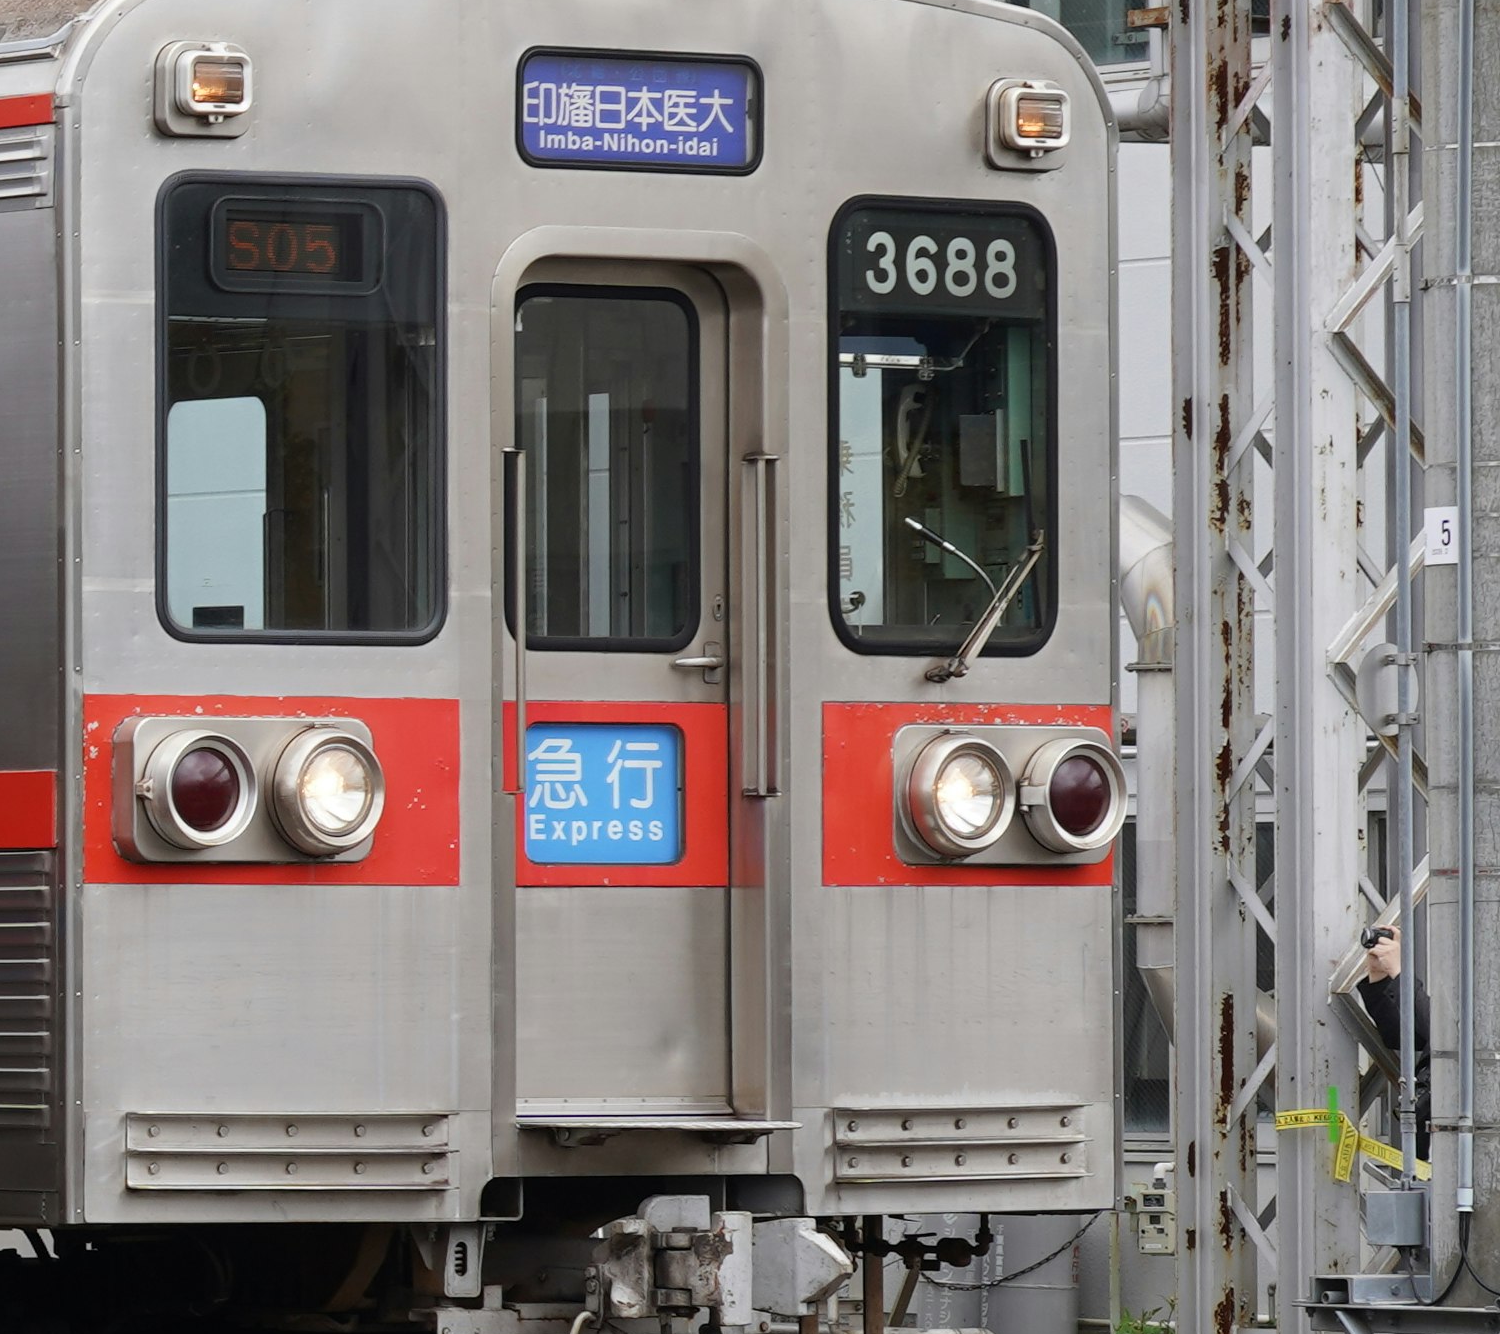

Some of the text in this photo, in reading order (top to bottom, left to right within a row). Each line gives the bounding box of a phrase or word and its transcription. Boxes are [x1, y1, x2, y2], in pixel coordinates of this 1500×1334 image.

[523, 80, 734, 133] 印旛日本医大
[539, 130, 718, 156] Imba-Nihon-idai
[229, 221, 336, 272] S05
[866, 231, 1014, 295] 3688
[1441, 519, 1451, 546] 5
[528, 739, 661, 809] 急行
[530, 814, 661, 843] Express
